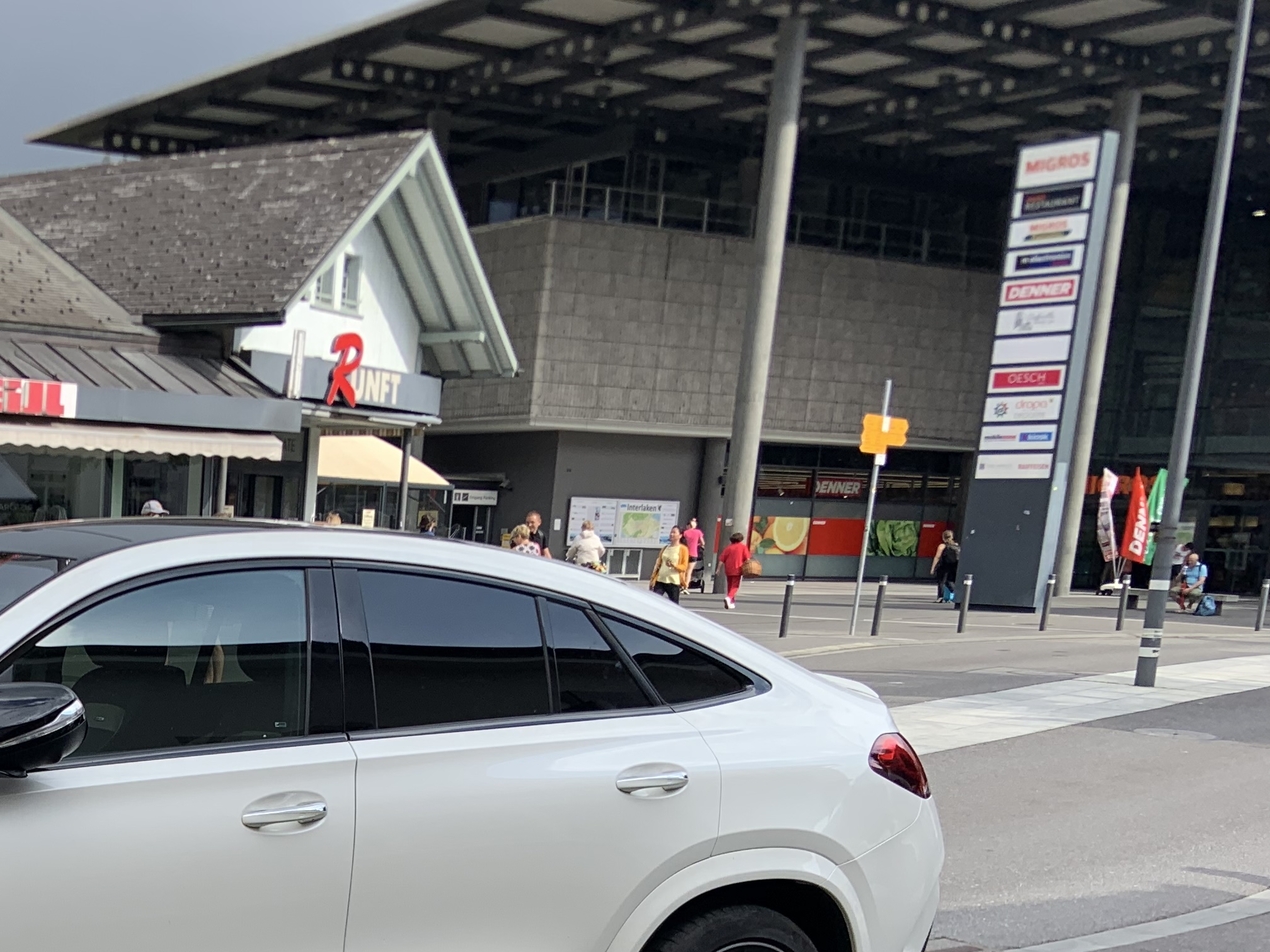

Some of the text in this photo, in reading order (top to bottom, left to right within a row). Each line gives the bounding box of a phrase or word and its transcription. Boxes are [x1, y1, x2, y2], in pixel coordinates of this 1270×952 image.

[1026, 152, 1090, 174] MIGROS
[1007, 282, 1073, 300] DENNER
[1008, 372, 1047, 384] OESCH
[626, 504, 656, 512] Interlaken
